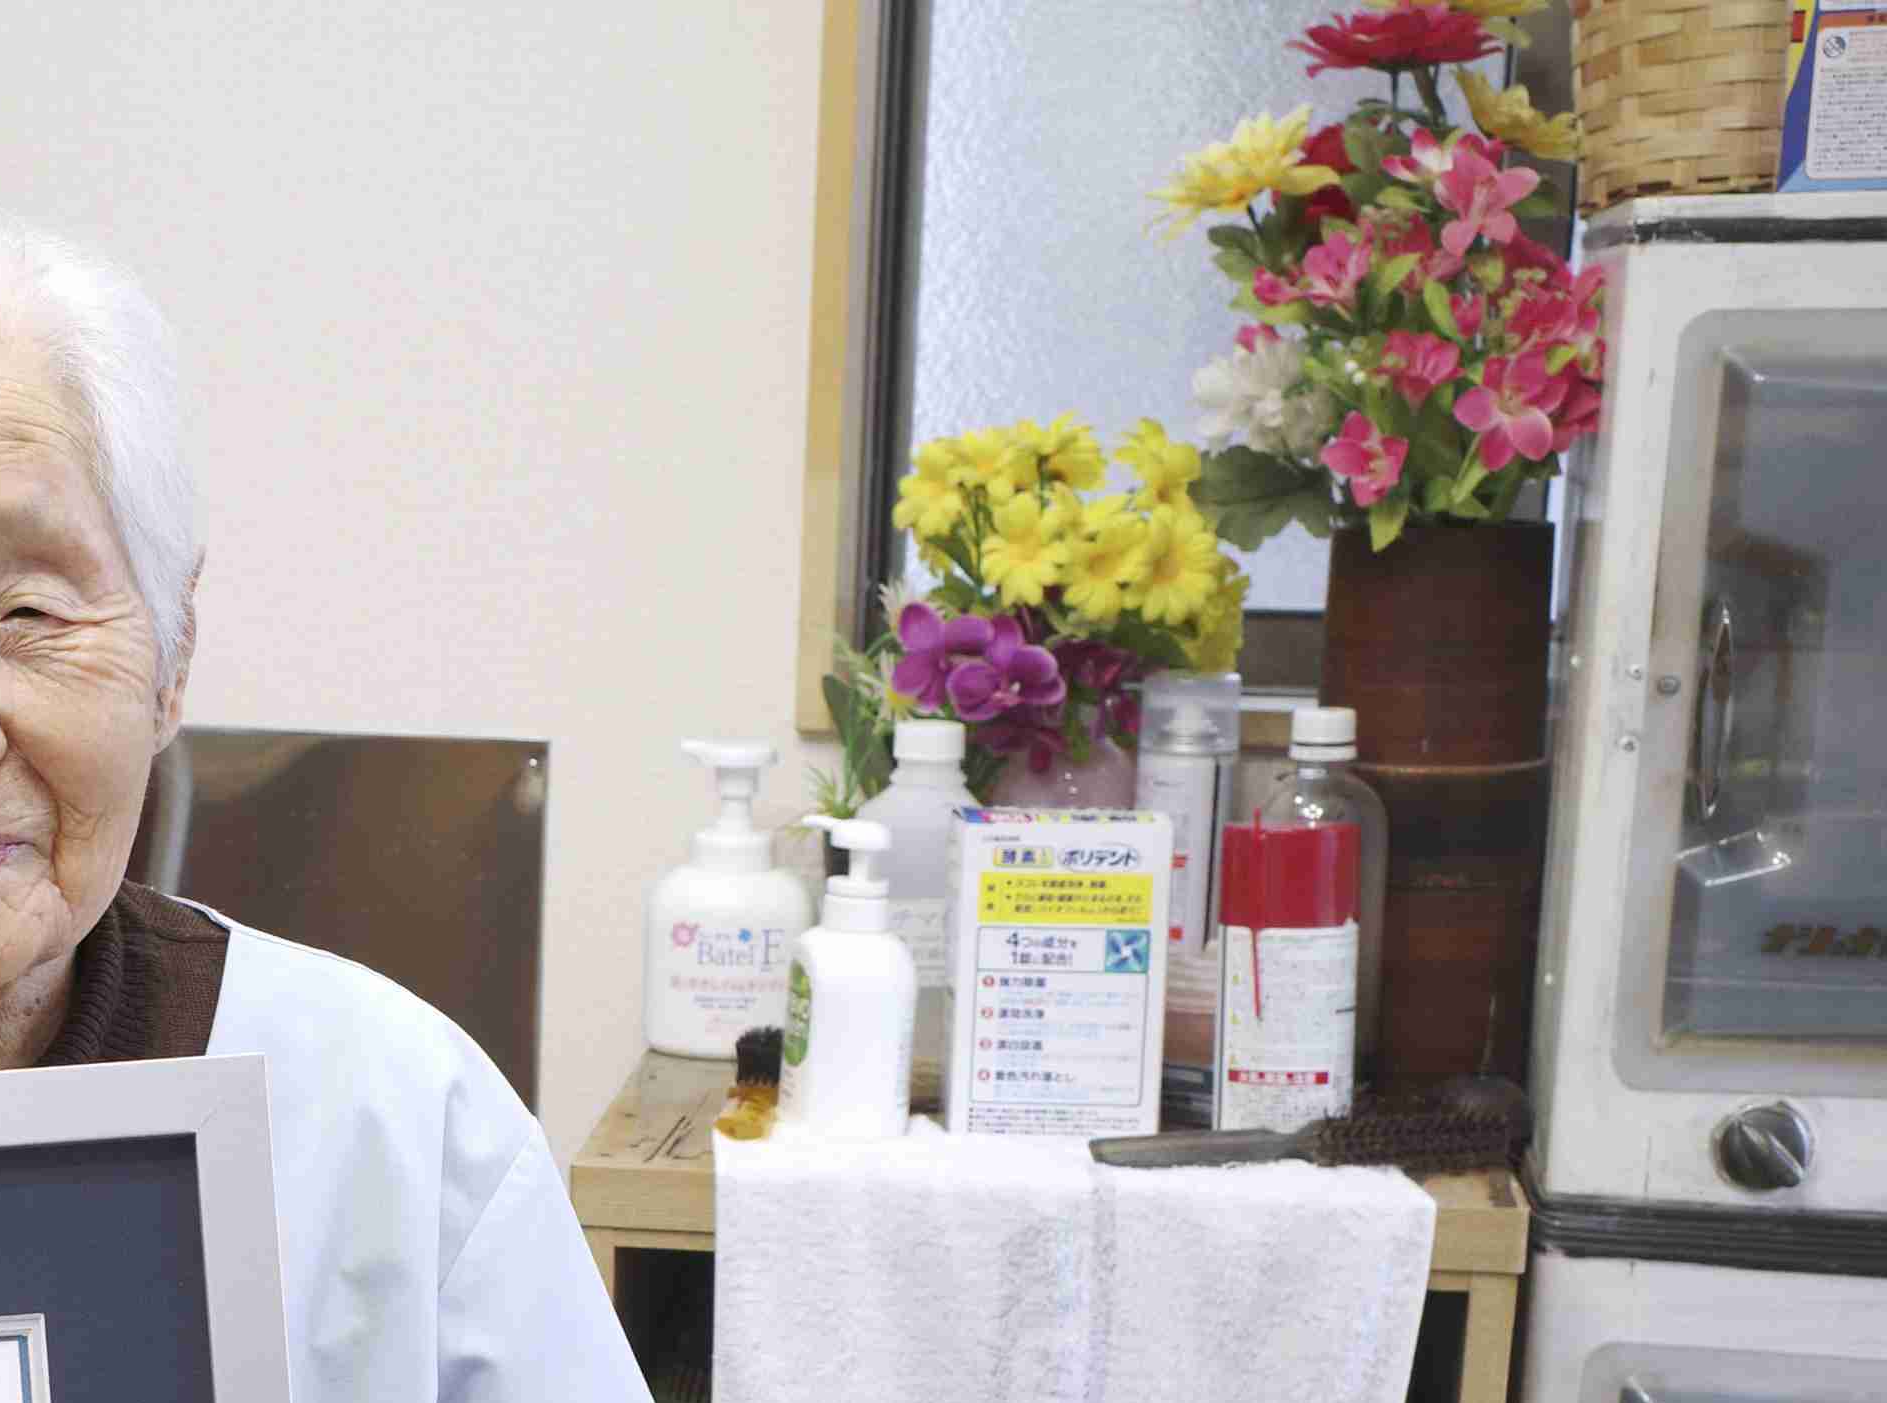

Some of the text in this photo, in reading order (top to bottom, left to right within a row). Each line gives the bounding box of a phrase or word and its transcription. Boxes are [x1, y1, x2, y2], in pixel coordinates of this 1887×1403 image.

[1063, 847, 1138, 868] ポリデント
